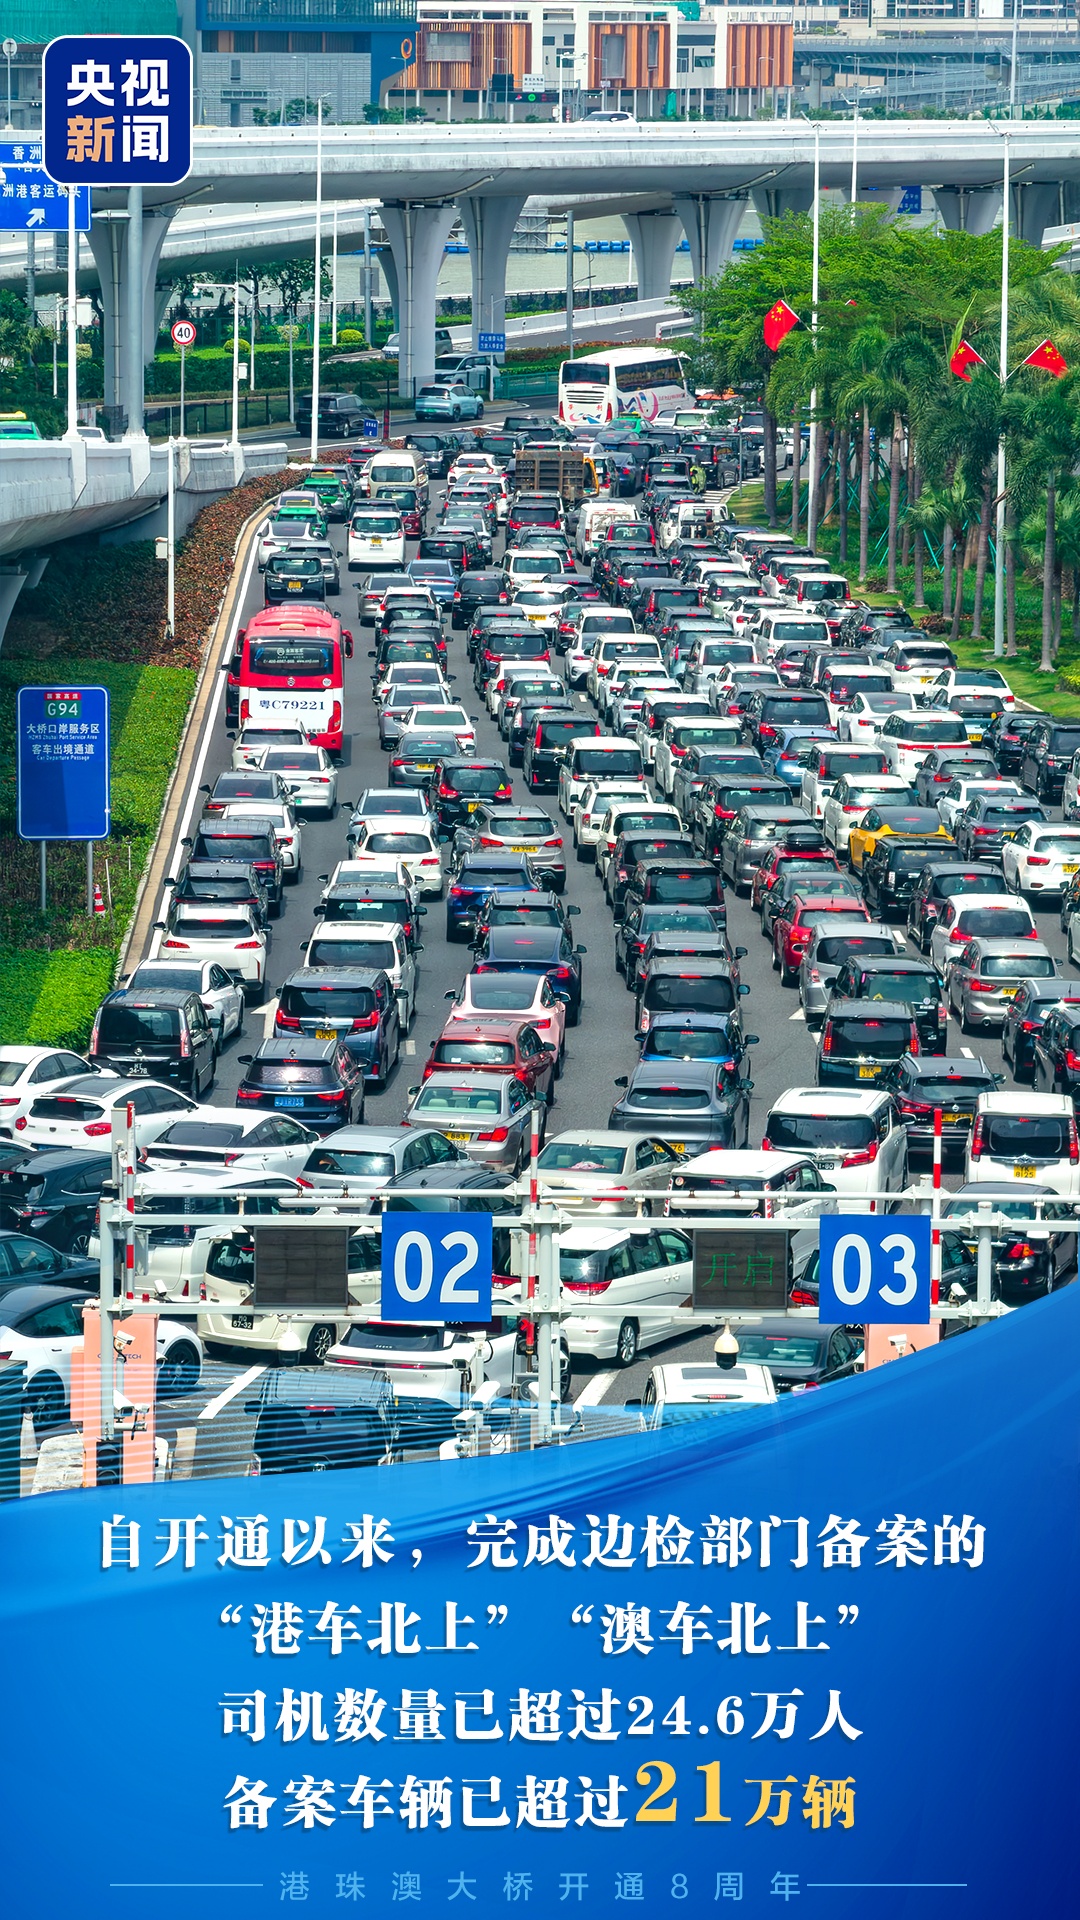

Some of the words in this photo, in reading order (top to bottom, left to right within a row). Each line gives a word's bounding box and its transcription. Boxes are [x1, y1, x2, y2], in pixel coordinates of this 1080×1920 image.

[177, 327, 190, 339] 40
[47, 702, 79, 716] G94
[260, 700, 325, 710] 粤C79221
[26, 723, 101, 734] 大桥口岸服务区
[32, 744, 95, 755] 客车出境通道
[395, 1231, 479, 1303] 02
[701, 1251, 774, 1287] 开启
[832, 1234, 917, 1306] 03
